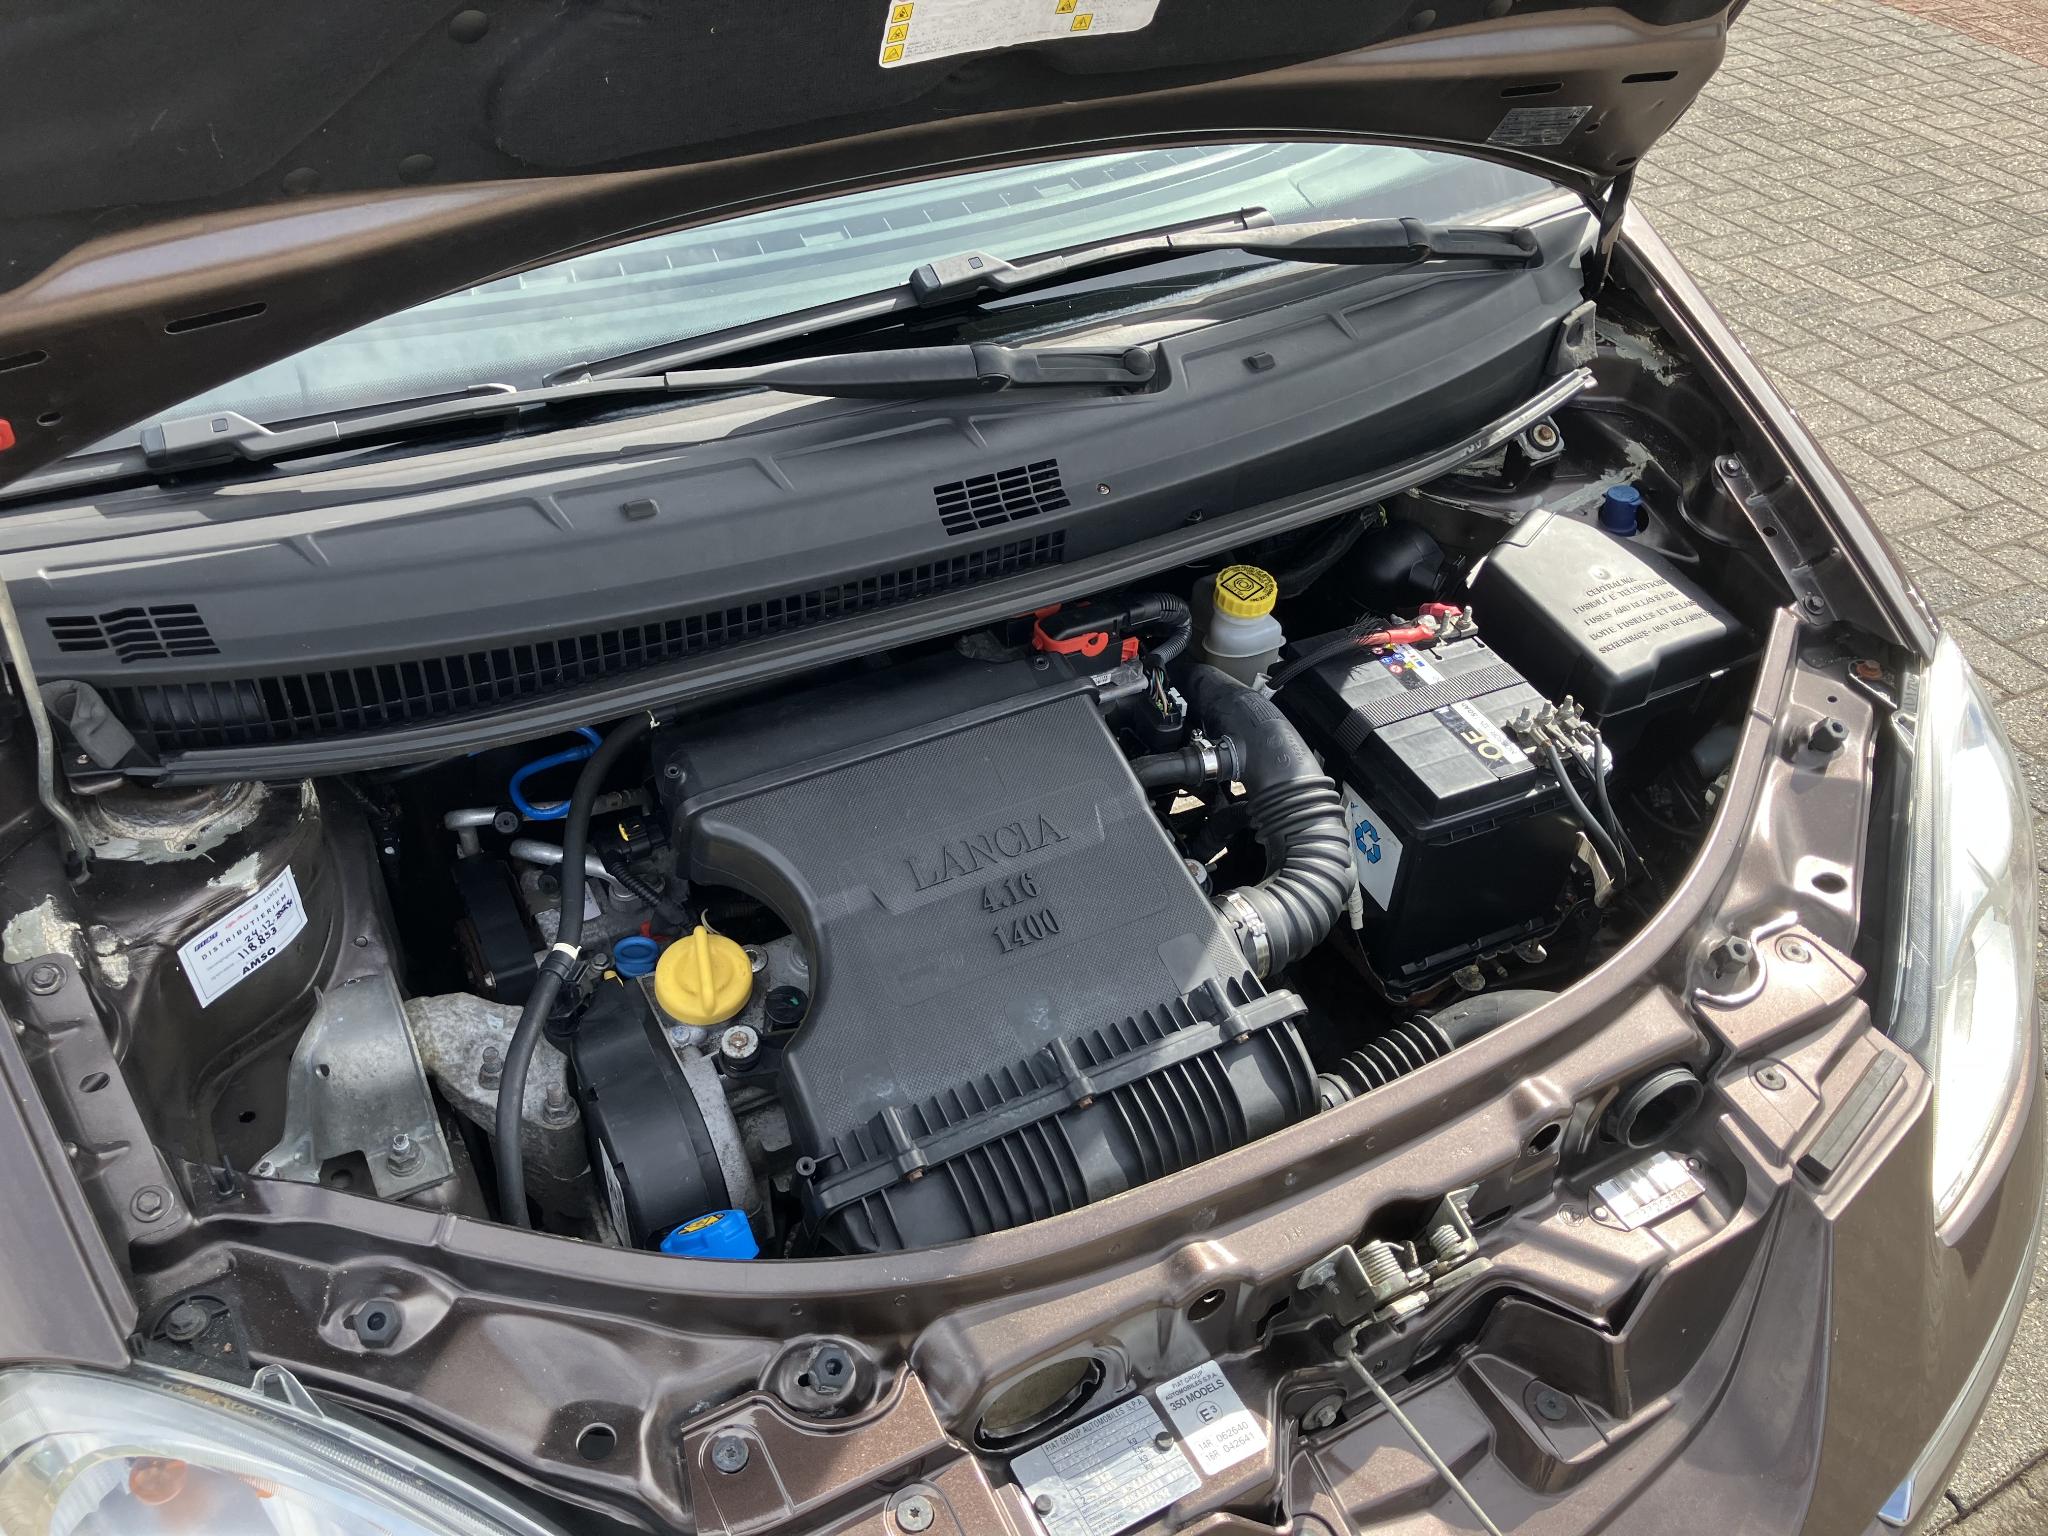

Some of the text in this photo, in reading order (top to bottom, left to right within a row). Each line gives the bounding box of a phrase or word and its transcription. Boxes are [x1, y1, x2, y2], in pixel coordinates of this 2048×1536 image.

[1586, 575, 1637, 597] CENTRALINA
[1584, 611, 1612, 625] FUSES
[1615, 605, 1631, 615] AND
[1618, 611, 1656, 629] FUSIBLES
[1656, 607, 1669, 617] ET
[1653, 621, 1671, 633] UND
[904, 814, 1069, 891] LANCIA
[982, 872, 1040, 913] 4.16
[993, 908, 1061, 953] 1400
[242, 947, 275, 975] AMSO
[1171, 1369, 1203, 1389] FIAT GROUP
[1165, 1380, 1202, 1401] AUTOMOBILES
[1169, 1378, 1224, 1411] 350 MODELS
[1044, 1439, 1060, 1452] FIAT
[1059, 1428, 1082, 1445] GROUP
[1081, 1407, 1125, 1433] AUTOMOBILES
[1215, 1420, 1248, 1442] 062640
[1126, 1435, 1138, 1447] kg
[1222, 1431, 1255, 1453] 042641
